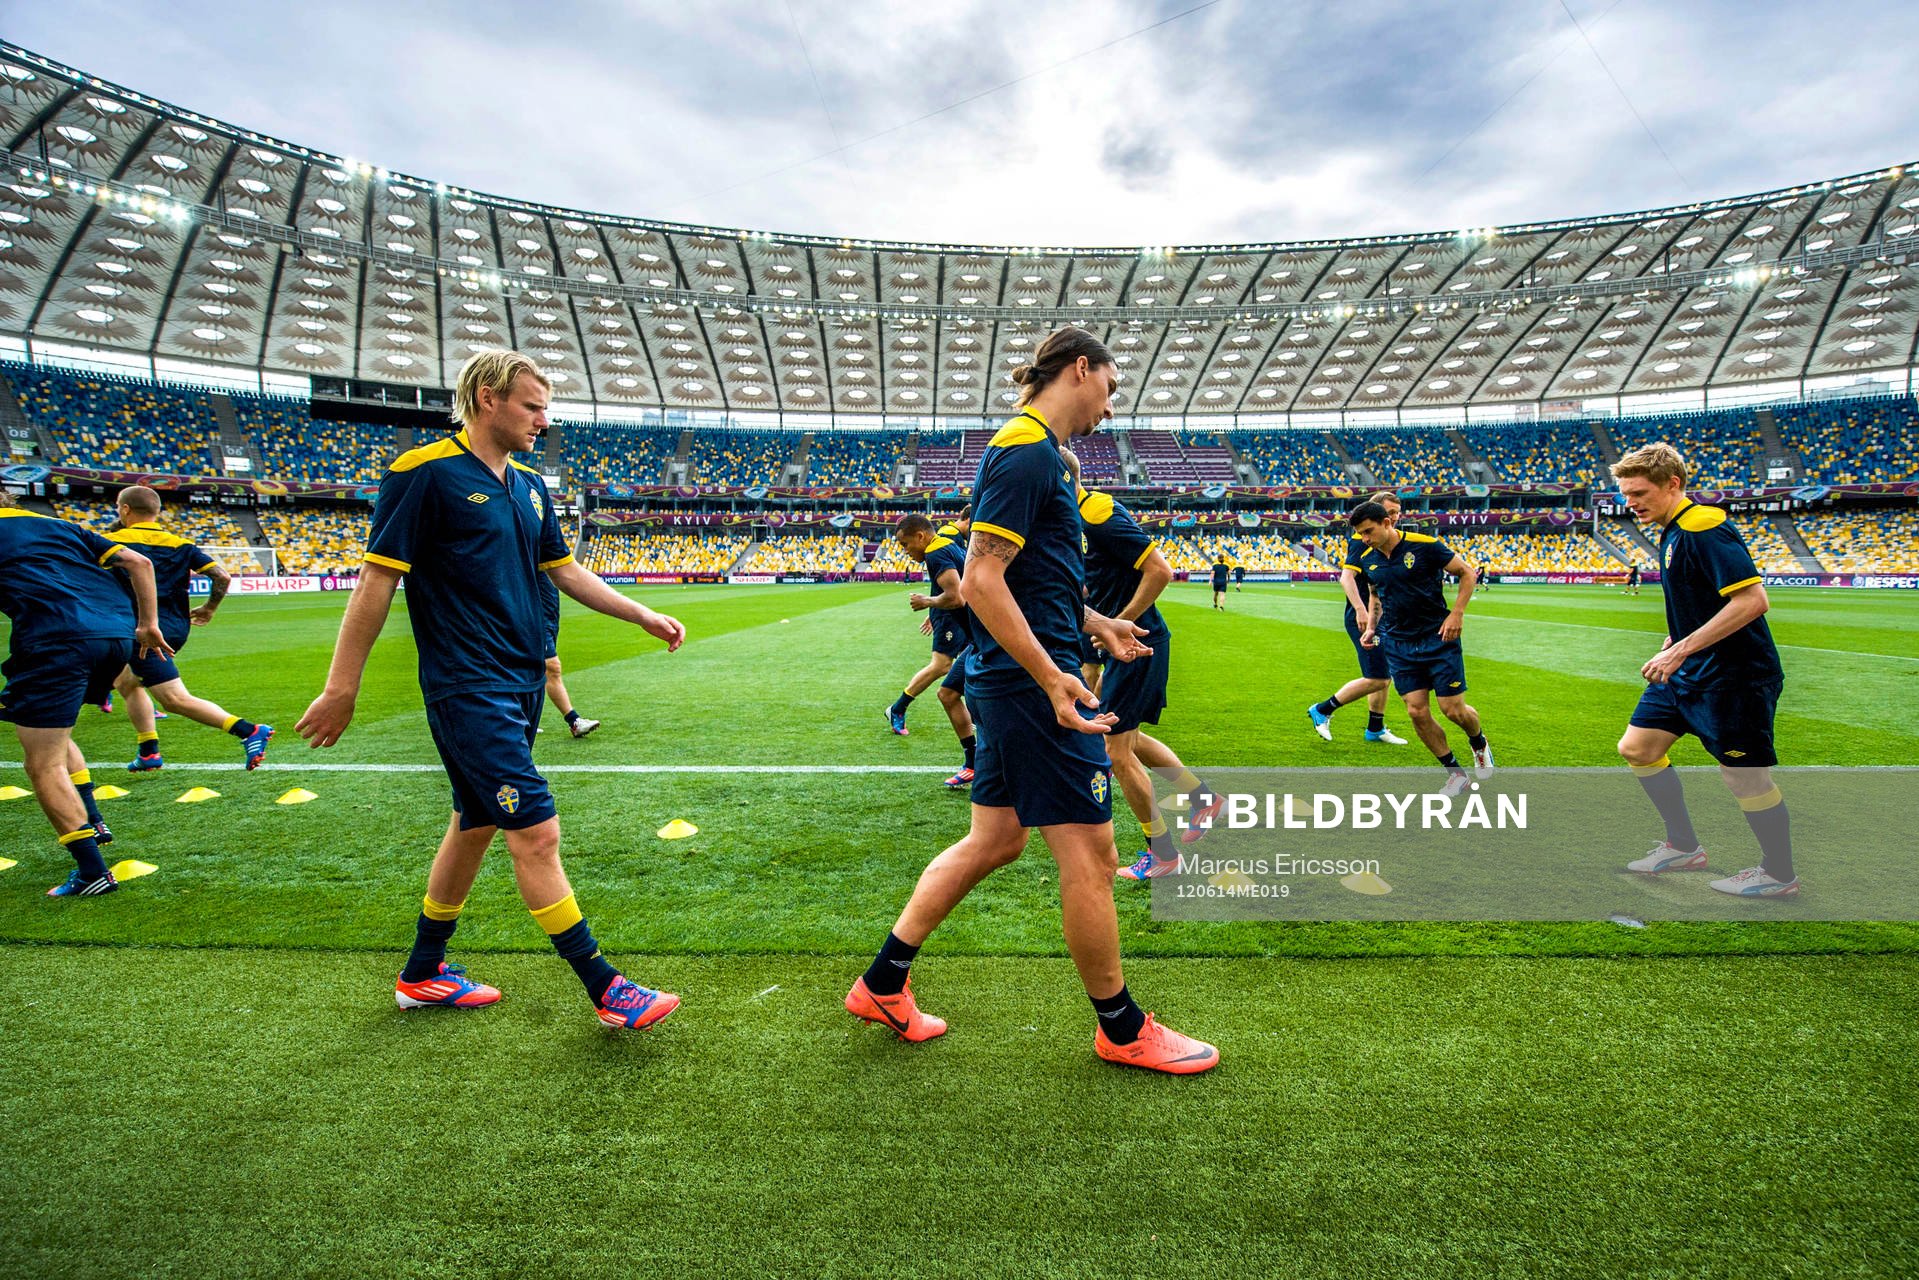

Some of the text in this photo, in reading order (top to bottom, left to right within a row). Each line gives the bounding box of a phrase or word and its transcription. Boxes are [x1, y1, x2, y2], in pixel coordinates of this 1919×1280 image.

[9, 429, 29, 438] 08
[1769, 459, 1784, 467] 62
[673, 516, 711, 525] KYIV
[1449, 515, 1488, 525] KYIV
[241, 578, 310, 591] SHARP
